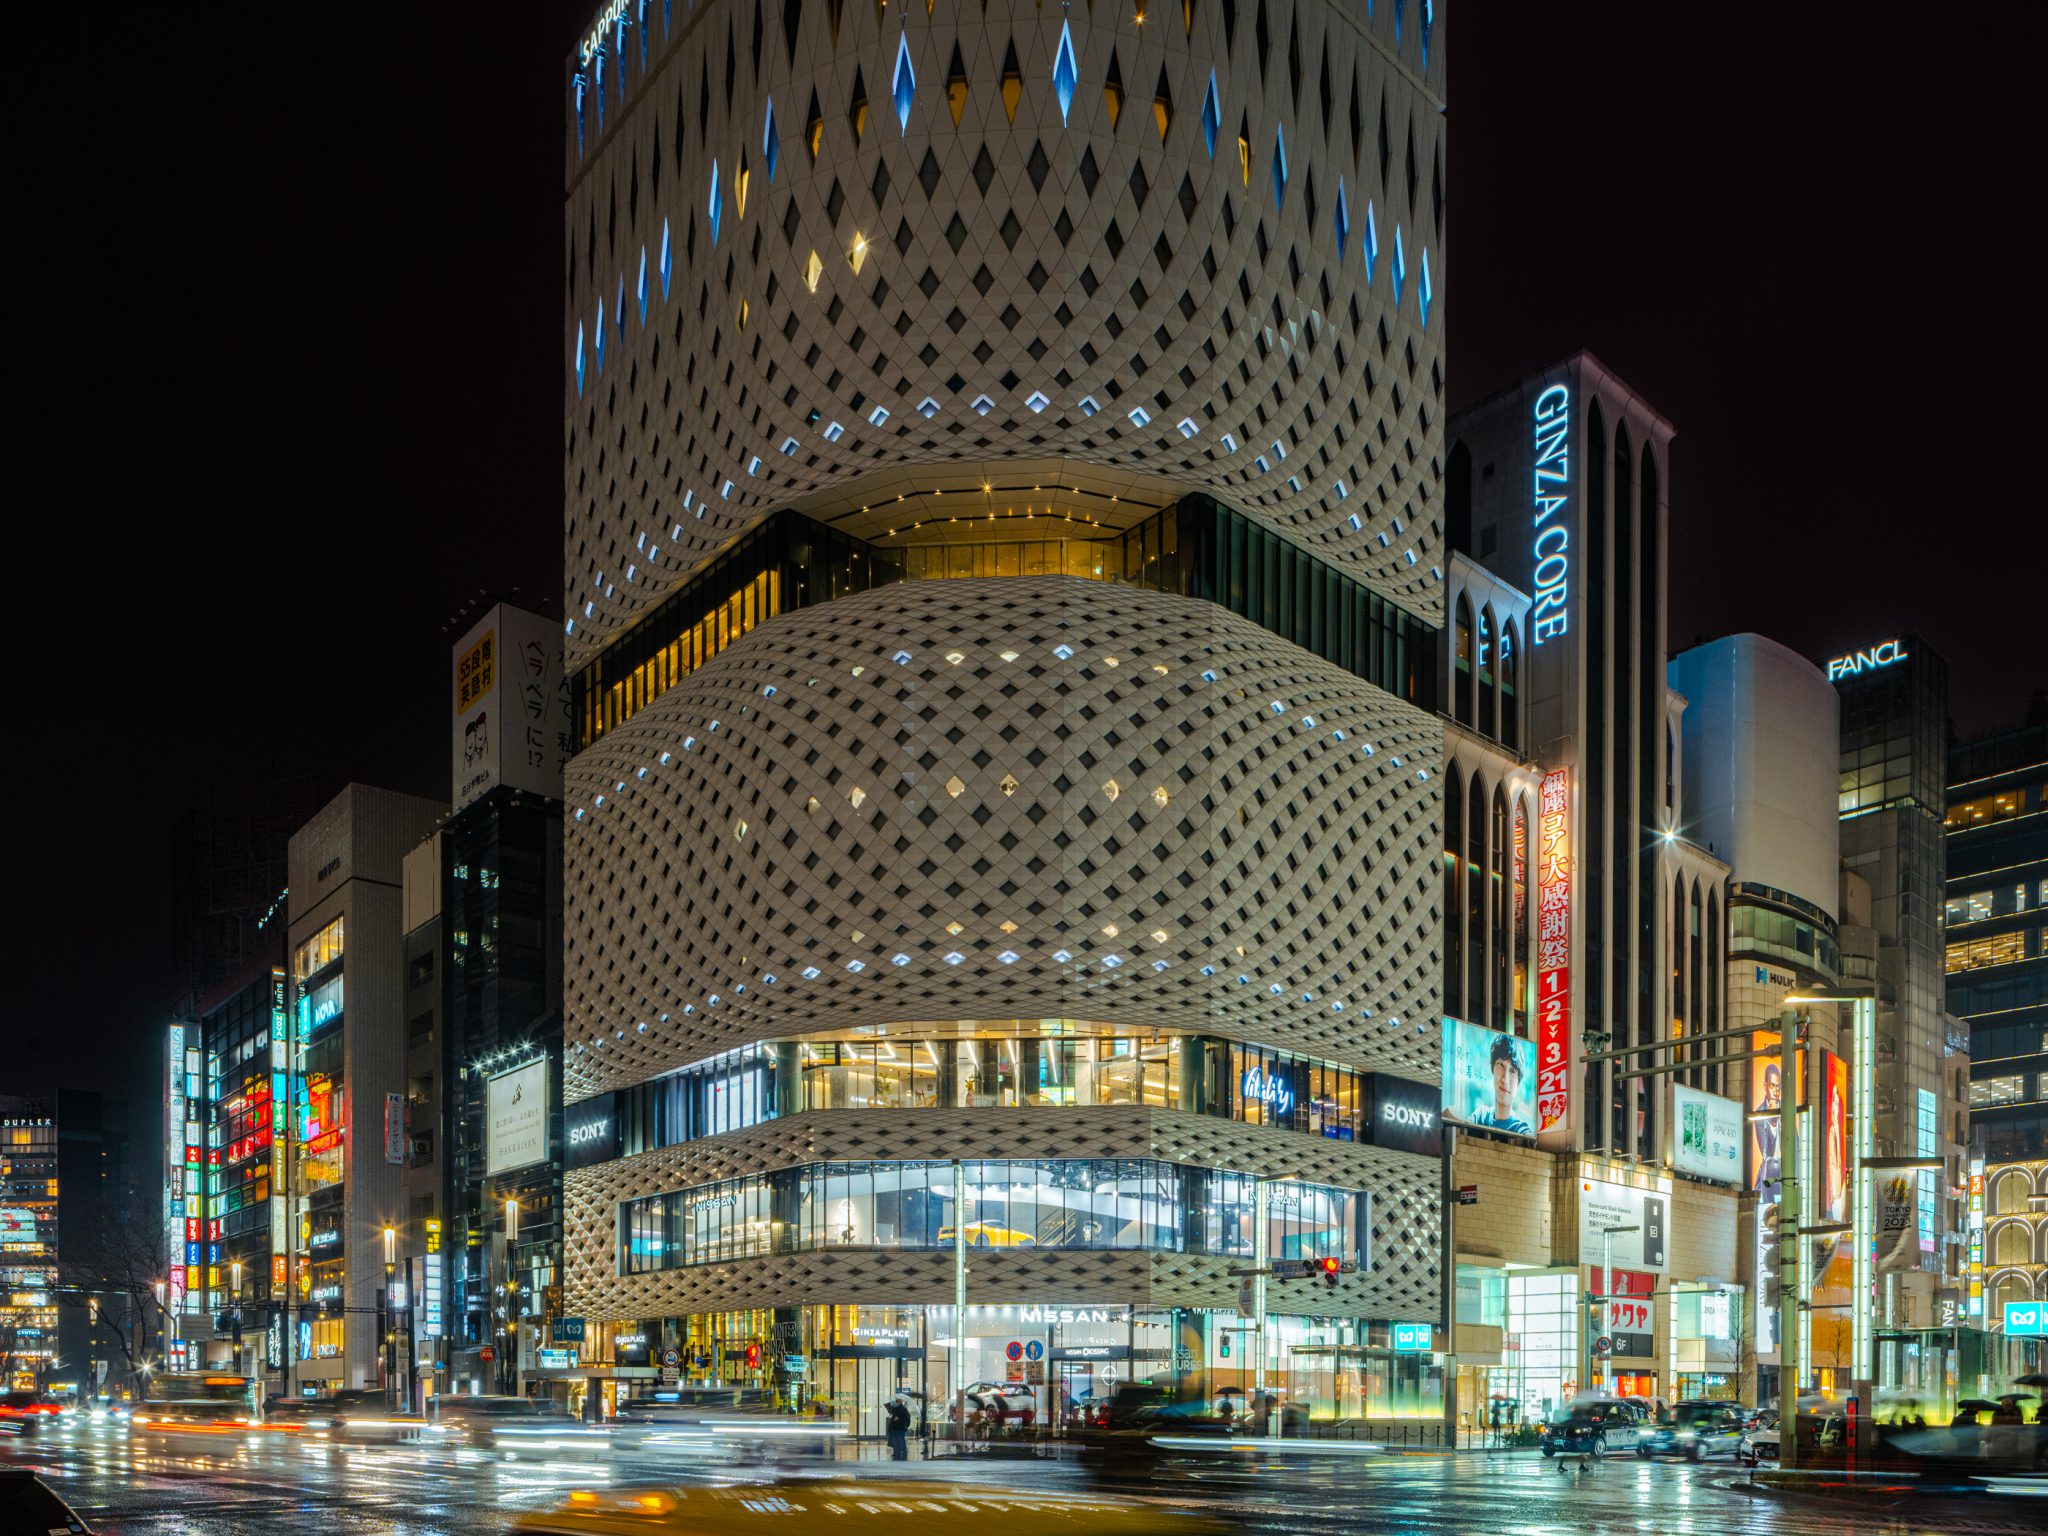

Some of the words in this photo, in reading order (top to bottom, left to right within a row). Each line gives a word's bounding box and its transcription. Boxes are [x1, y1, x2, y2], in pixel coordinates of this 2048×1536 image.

[1534, 383, 1568, 528] GINZA
[1534, 525, 1568, 645] CORE
[1828, 640, 1908, 682] FANCL
[460, 663, 491, 707] 英語村
[1540, 769, 1569, 968] 銀座コア大感謝祭
[1770, 972, 1794, 988] HULIC
[315, 1000, 336, 1024] NOVA
[4, 1119, 51, 1127] DUPLEX
[1383, 1103, 1433, 1129] SONY
[571, 1120, 608, 1145] SONY
[498, 1137, 537, 1157] HAKKAISAN
[695, 1195, 737, 1212] NISSAN
[1021, 1310, 1107, 1323] NISSAN
[771, 1321, 797, 1338] WINTER
[852, 1328, 880, 1336] GINZA
[881, 1328, 910, 1338] PLACE
[1616, 1337, 1627, 1351] 6F
